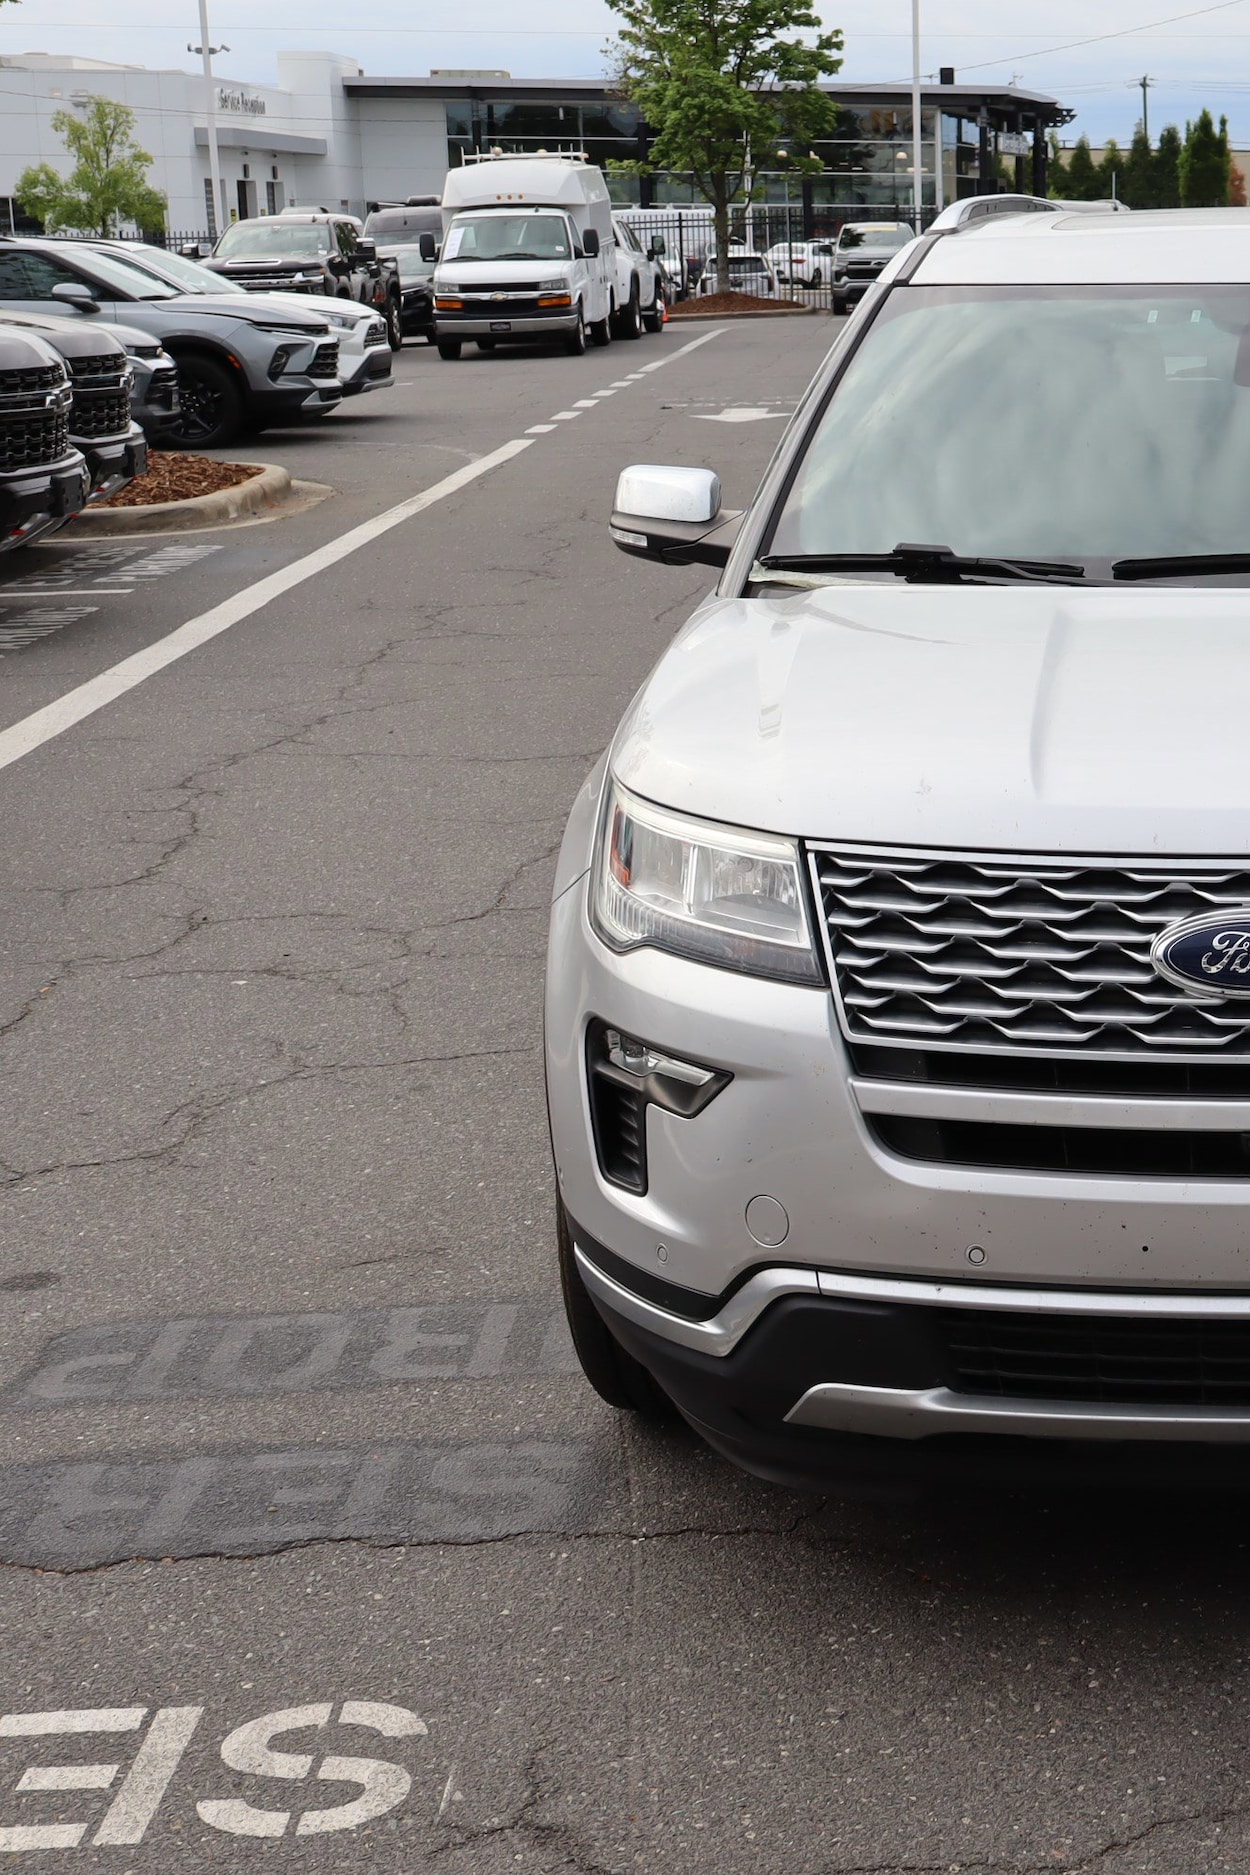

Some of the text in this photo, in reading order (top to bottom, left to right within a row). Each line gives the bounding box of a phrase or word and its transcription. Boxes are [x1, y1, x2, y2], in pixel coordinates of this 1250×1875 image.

[219, 88, 266, 115] Service Reception
[92, 545, 225, 583] PARKING
[0, 606, 100, 659] ARKING
